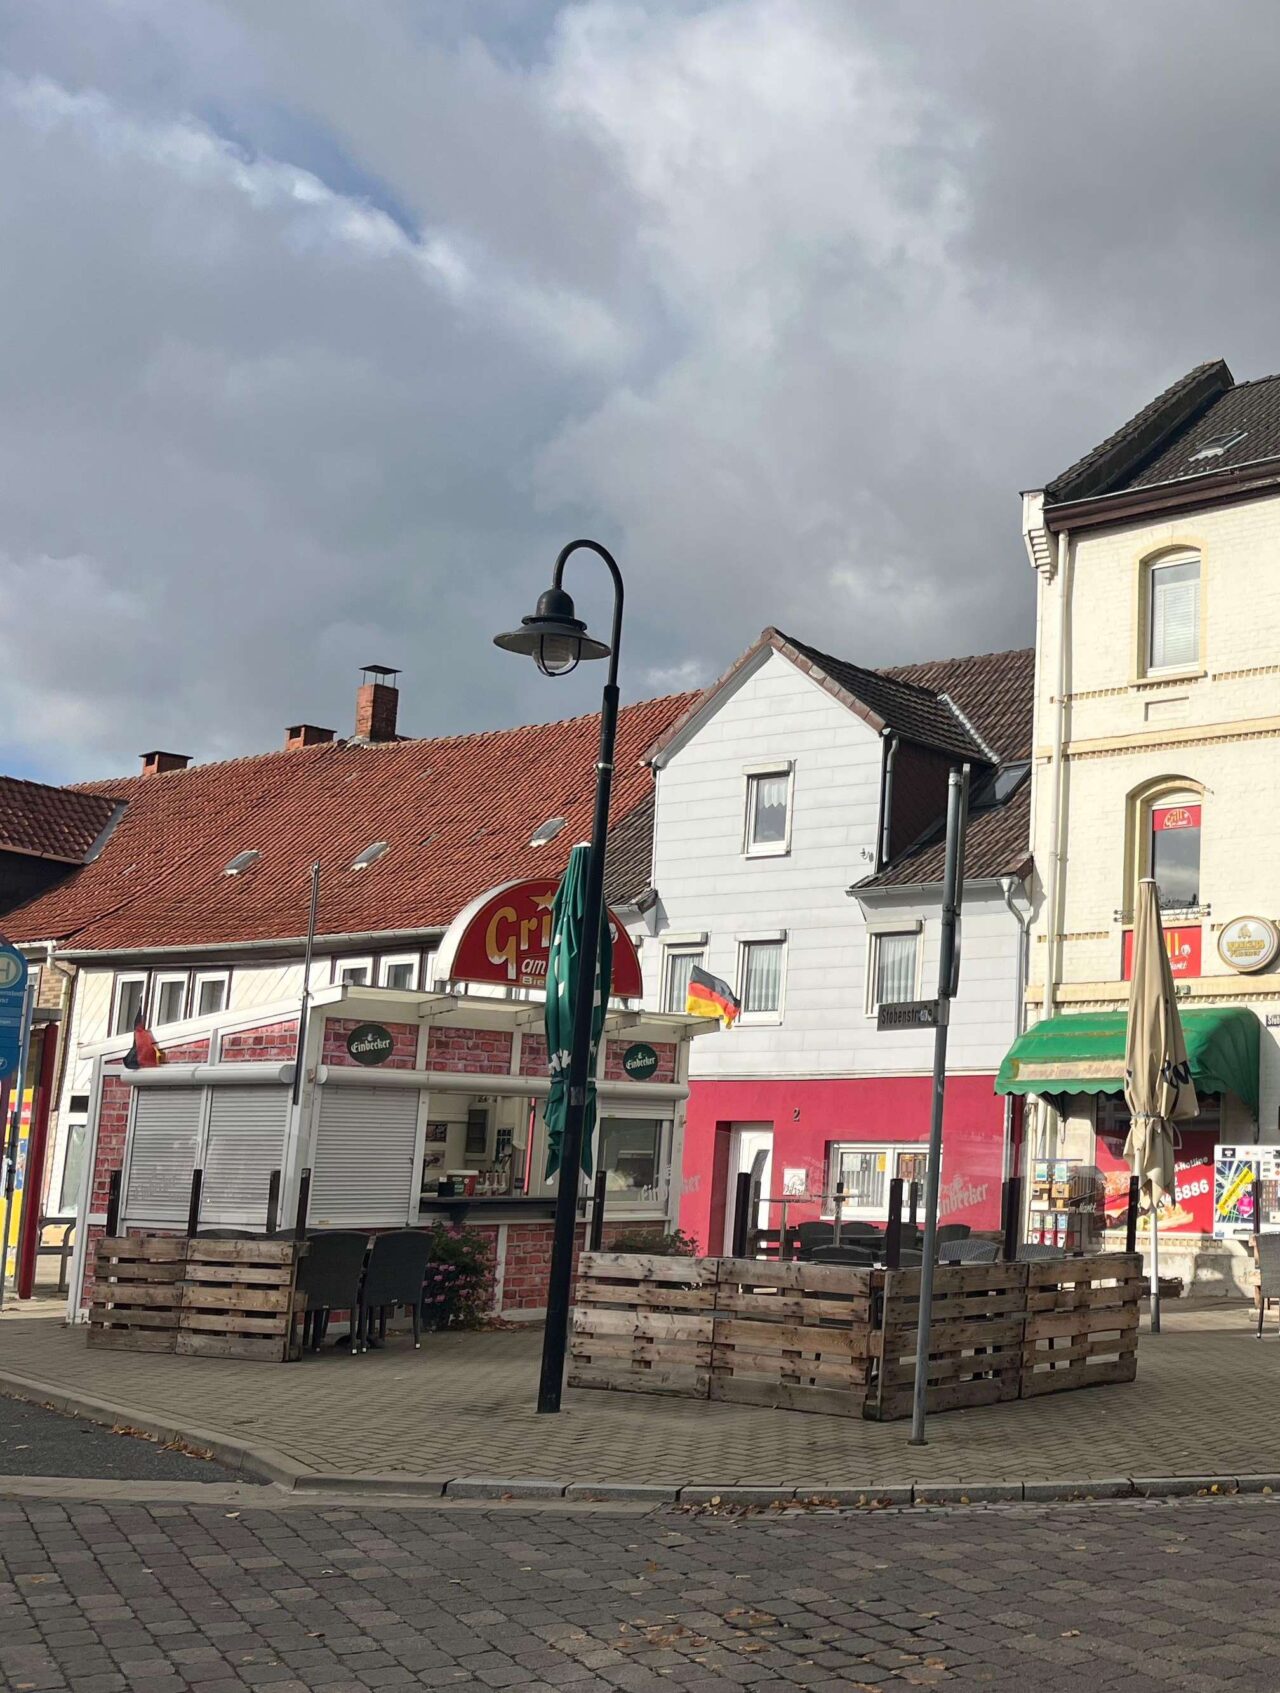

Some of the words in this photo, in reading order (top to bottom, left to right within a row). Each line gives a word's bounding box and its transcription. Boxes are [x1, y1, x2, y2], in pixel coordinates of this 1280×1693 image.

[486, 906, 550, 980] Gri
[521, 958, 546, 975] am
[351, 1038, 391, 1053] Einbecker
[793, 1108, 800, 1121] 2
[1163, 1178, 1210, 1204] 6886
